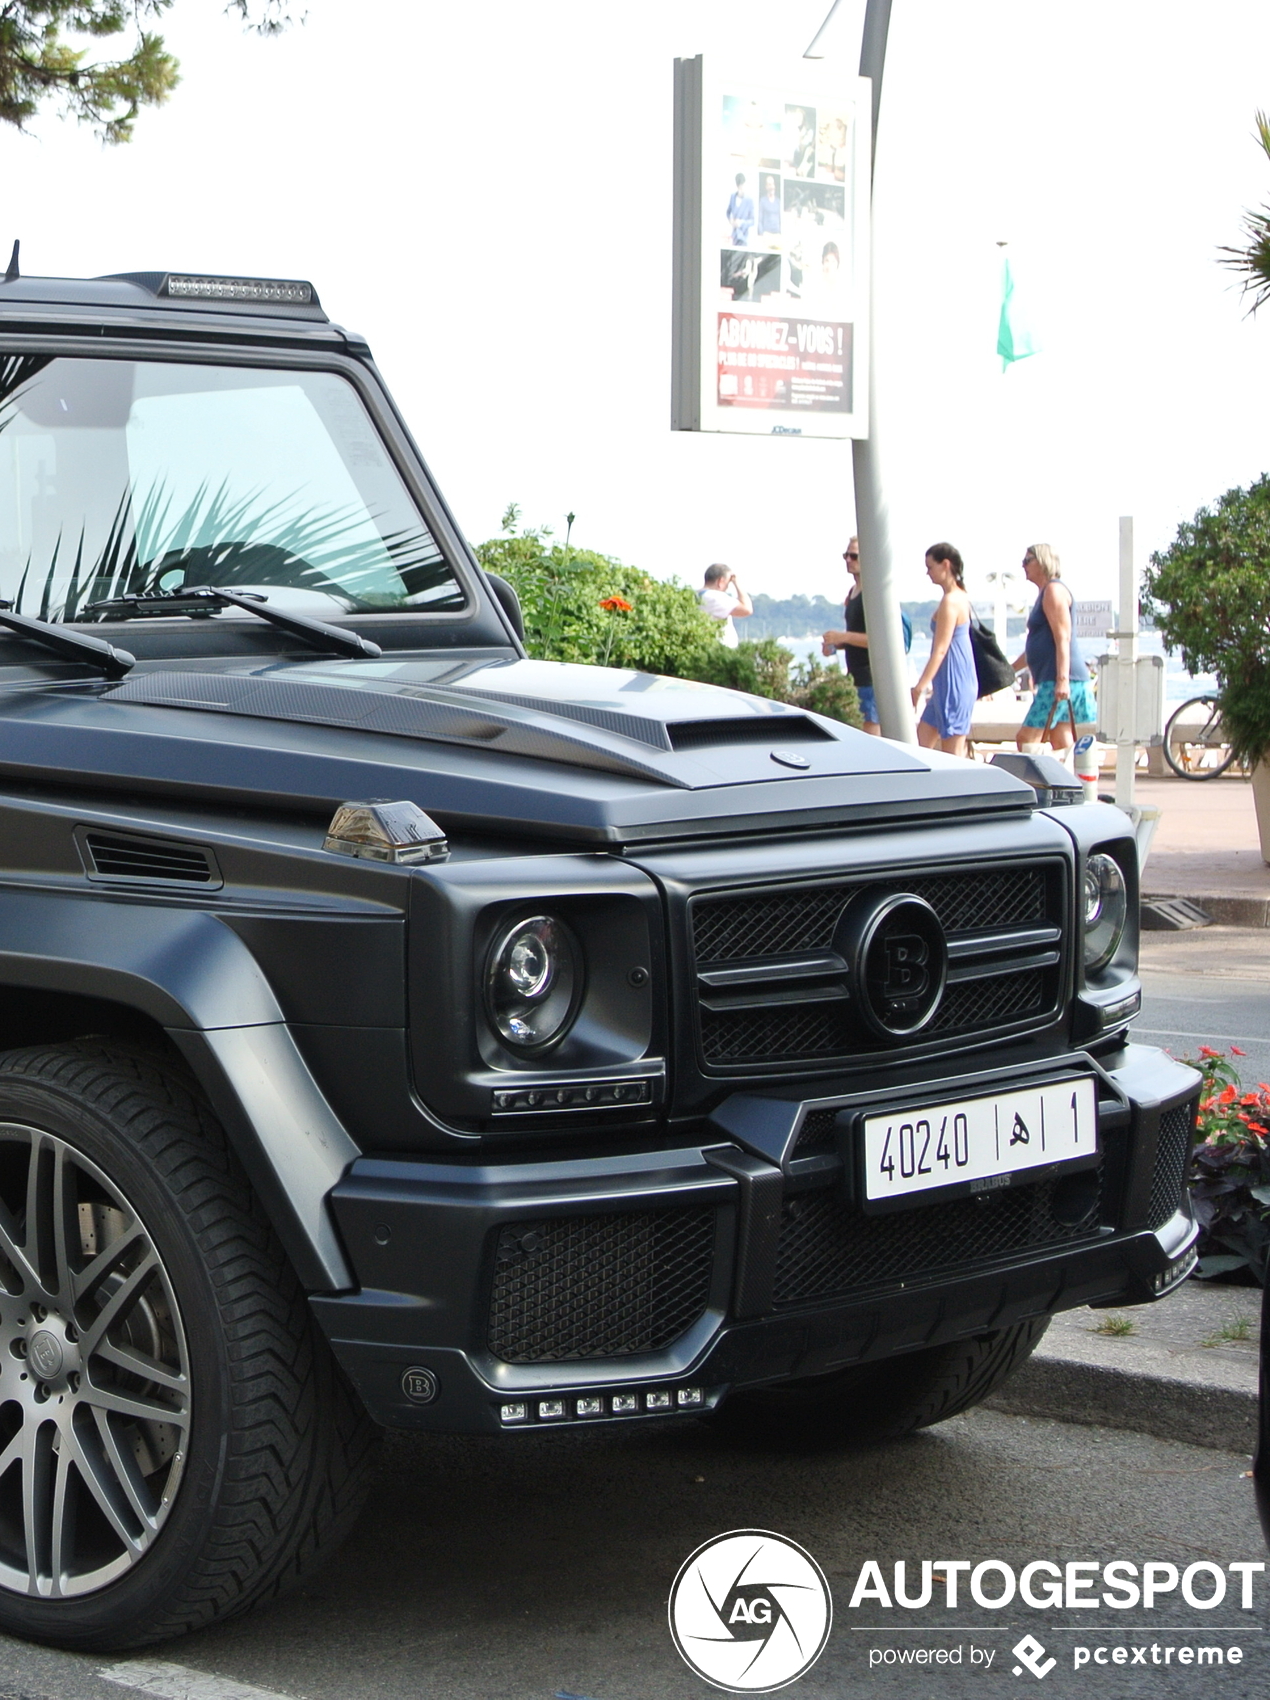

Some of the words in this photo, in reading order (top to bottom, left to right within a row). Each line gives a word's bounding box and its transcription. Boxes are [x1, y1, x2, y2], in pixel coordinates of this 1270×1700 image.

[718, 317, 835, 355] ABONNEZ-VOUS
[880, 1113, 969, 1181] 40240
[970, 1173, 1013, 1193] BRABUS
[409, 1375, 431, 1397] B
